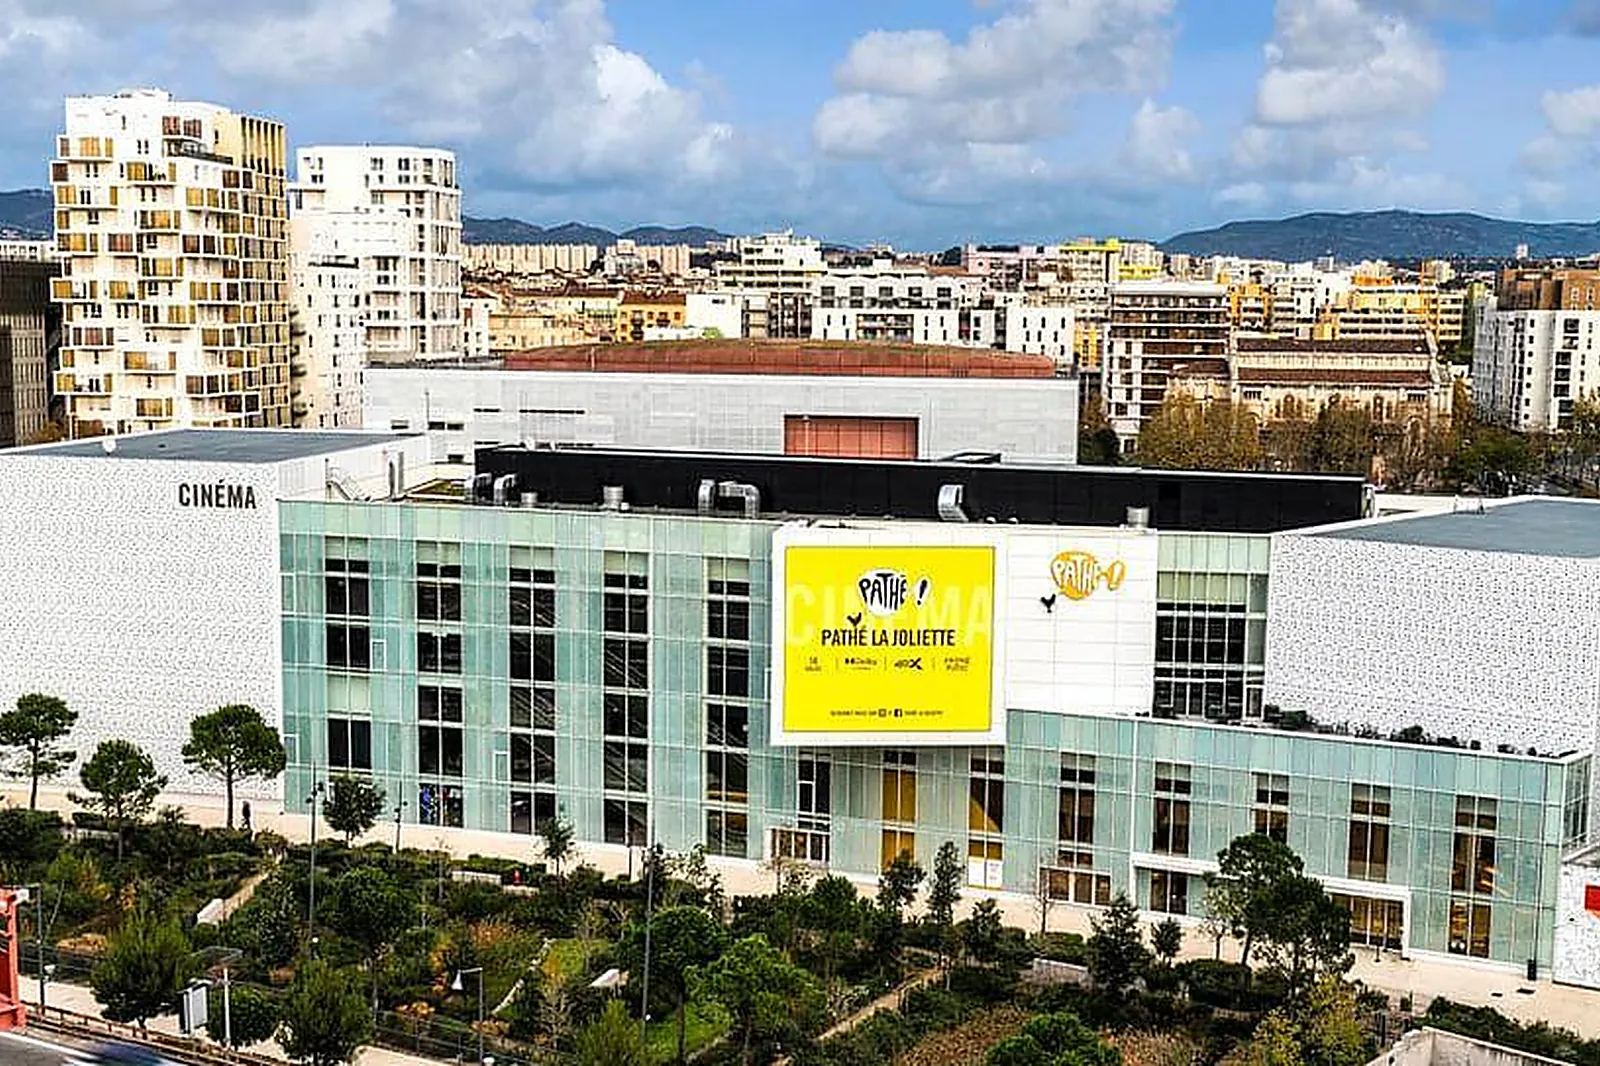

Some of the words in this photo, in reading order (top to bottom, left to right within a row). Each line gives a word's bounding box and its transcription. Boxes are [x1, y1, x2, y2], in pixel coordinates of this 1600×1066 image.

[179, 479, 257, 509] CINÉMA
[858, 573, 908, 611] PATHÉ
[821, 625, 867, 646] PATHÉ
[872, 629, 889, 646] LA
[892, 629, 956, 647] JOLIETTE
